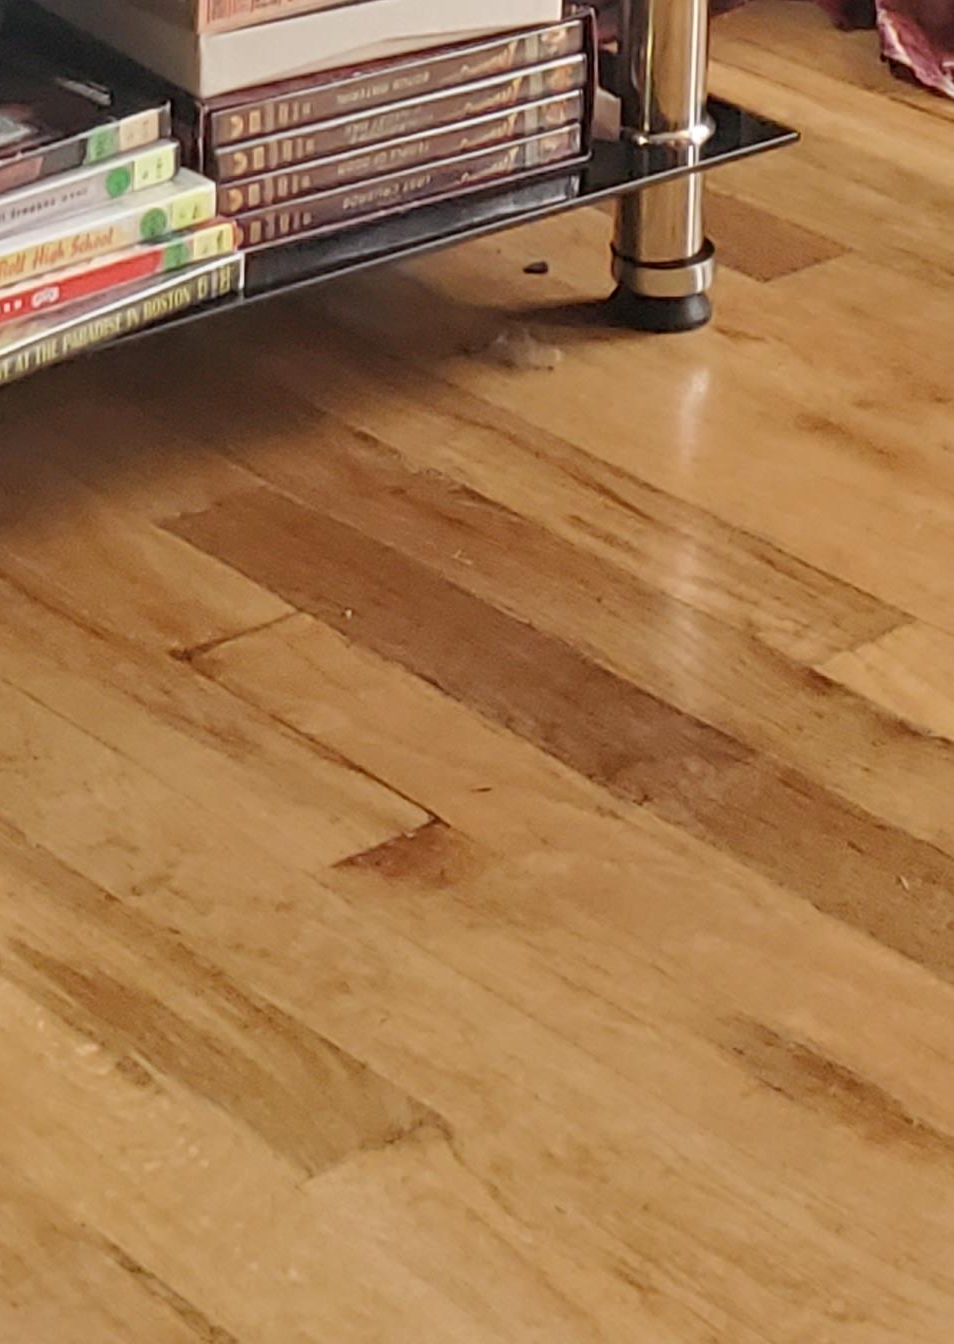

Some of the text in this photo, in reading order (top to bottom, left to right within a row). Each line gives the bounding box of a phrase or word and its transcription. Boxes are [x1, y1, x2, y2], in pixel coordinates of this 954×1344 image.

[32, 239, 65, 269] High
[71, 227, 114, 255] School
[15, 350, 31, 372] AT
[36, 339, 58, 367] THE
[62, 316, 122, 354] PARADISE
[143, 286, 192, 322] BOSTON
